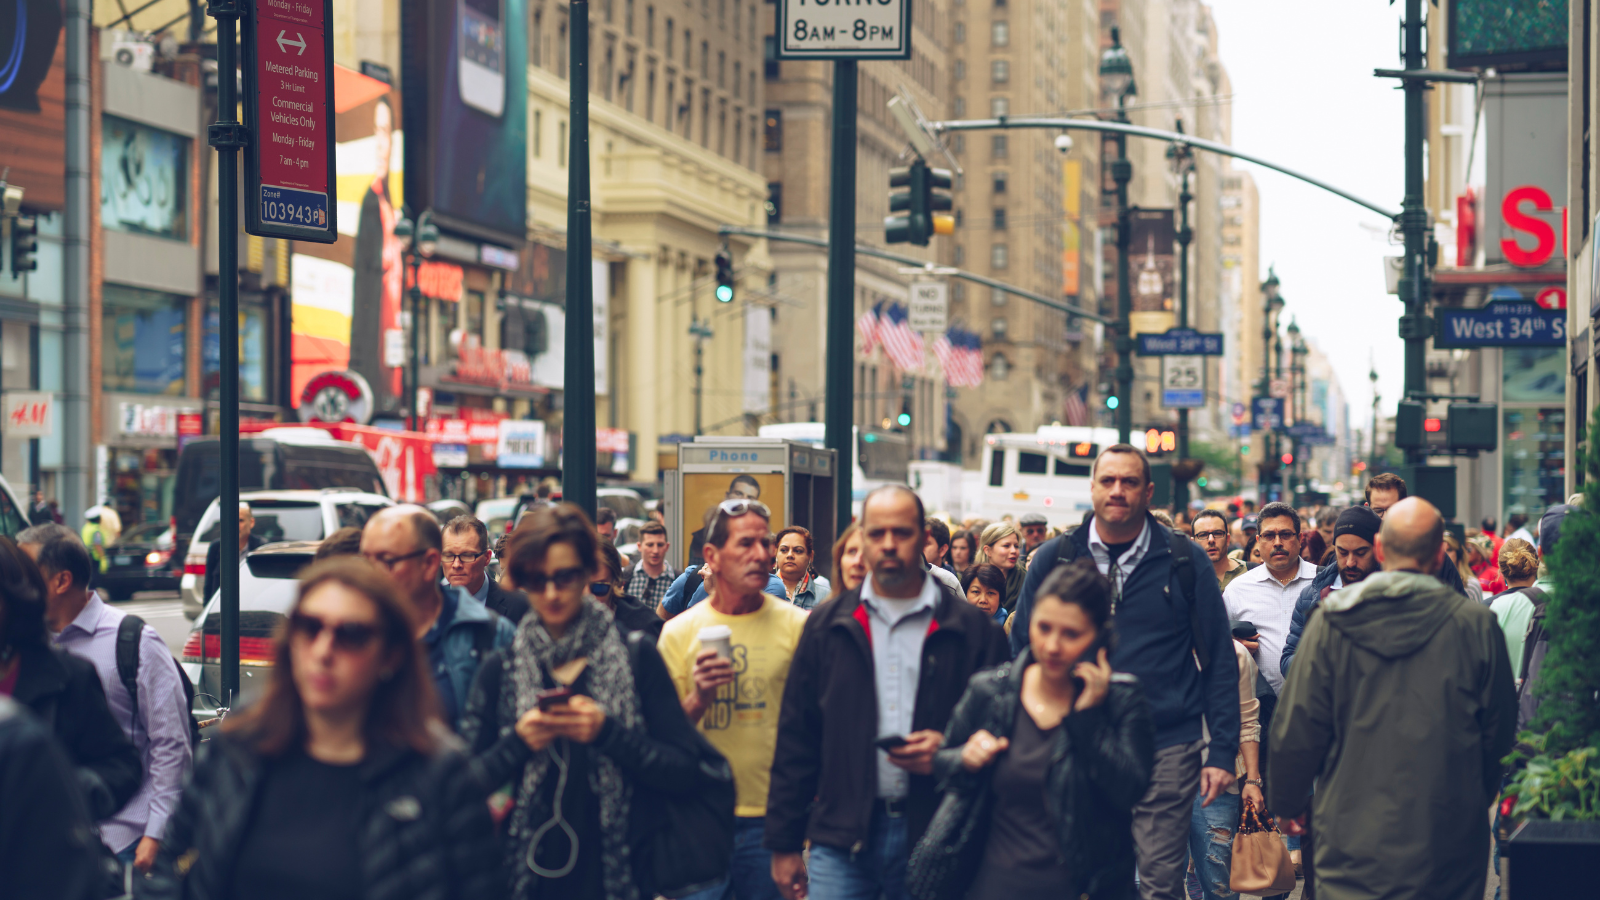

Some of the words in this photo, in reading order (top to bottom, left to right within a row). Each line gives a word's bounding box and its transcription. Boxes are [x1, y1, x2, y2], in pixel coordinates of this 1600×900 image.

[267, 0, 291, 13] Monday
[295, 3, 313, 17] Friday
[265, 60, 294, 76] Metered
[294, 65, 318, 83] Parking
[280, 80, 285, 90] 3
[285, 82, 292, 91] Hr
[292, 83, 306, 94] Limit
[272, 96, 314, 113] Commercial
[270, 111, 299, 126] Vehicles
[299, 115, 316, 131] Only
[272, 131, 295, 148] Monday
[298, 136, 315, 151] Friday
[263, 189, 281, 199] Zone#
[263, 200, 311, 224] 103943
[1499, 186, 1567, 269] S
[1452, 316, 1504, 339] West
[1509, 316, 1546, 339] 34th
[1169, 366, 1199, 388] 25
[709, 450, 759, 462] Phone
